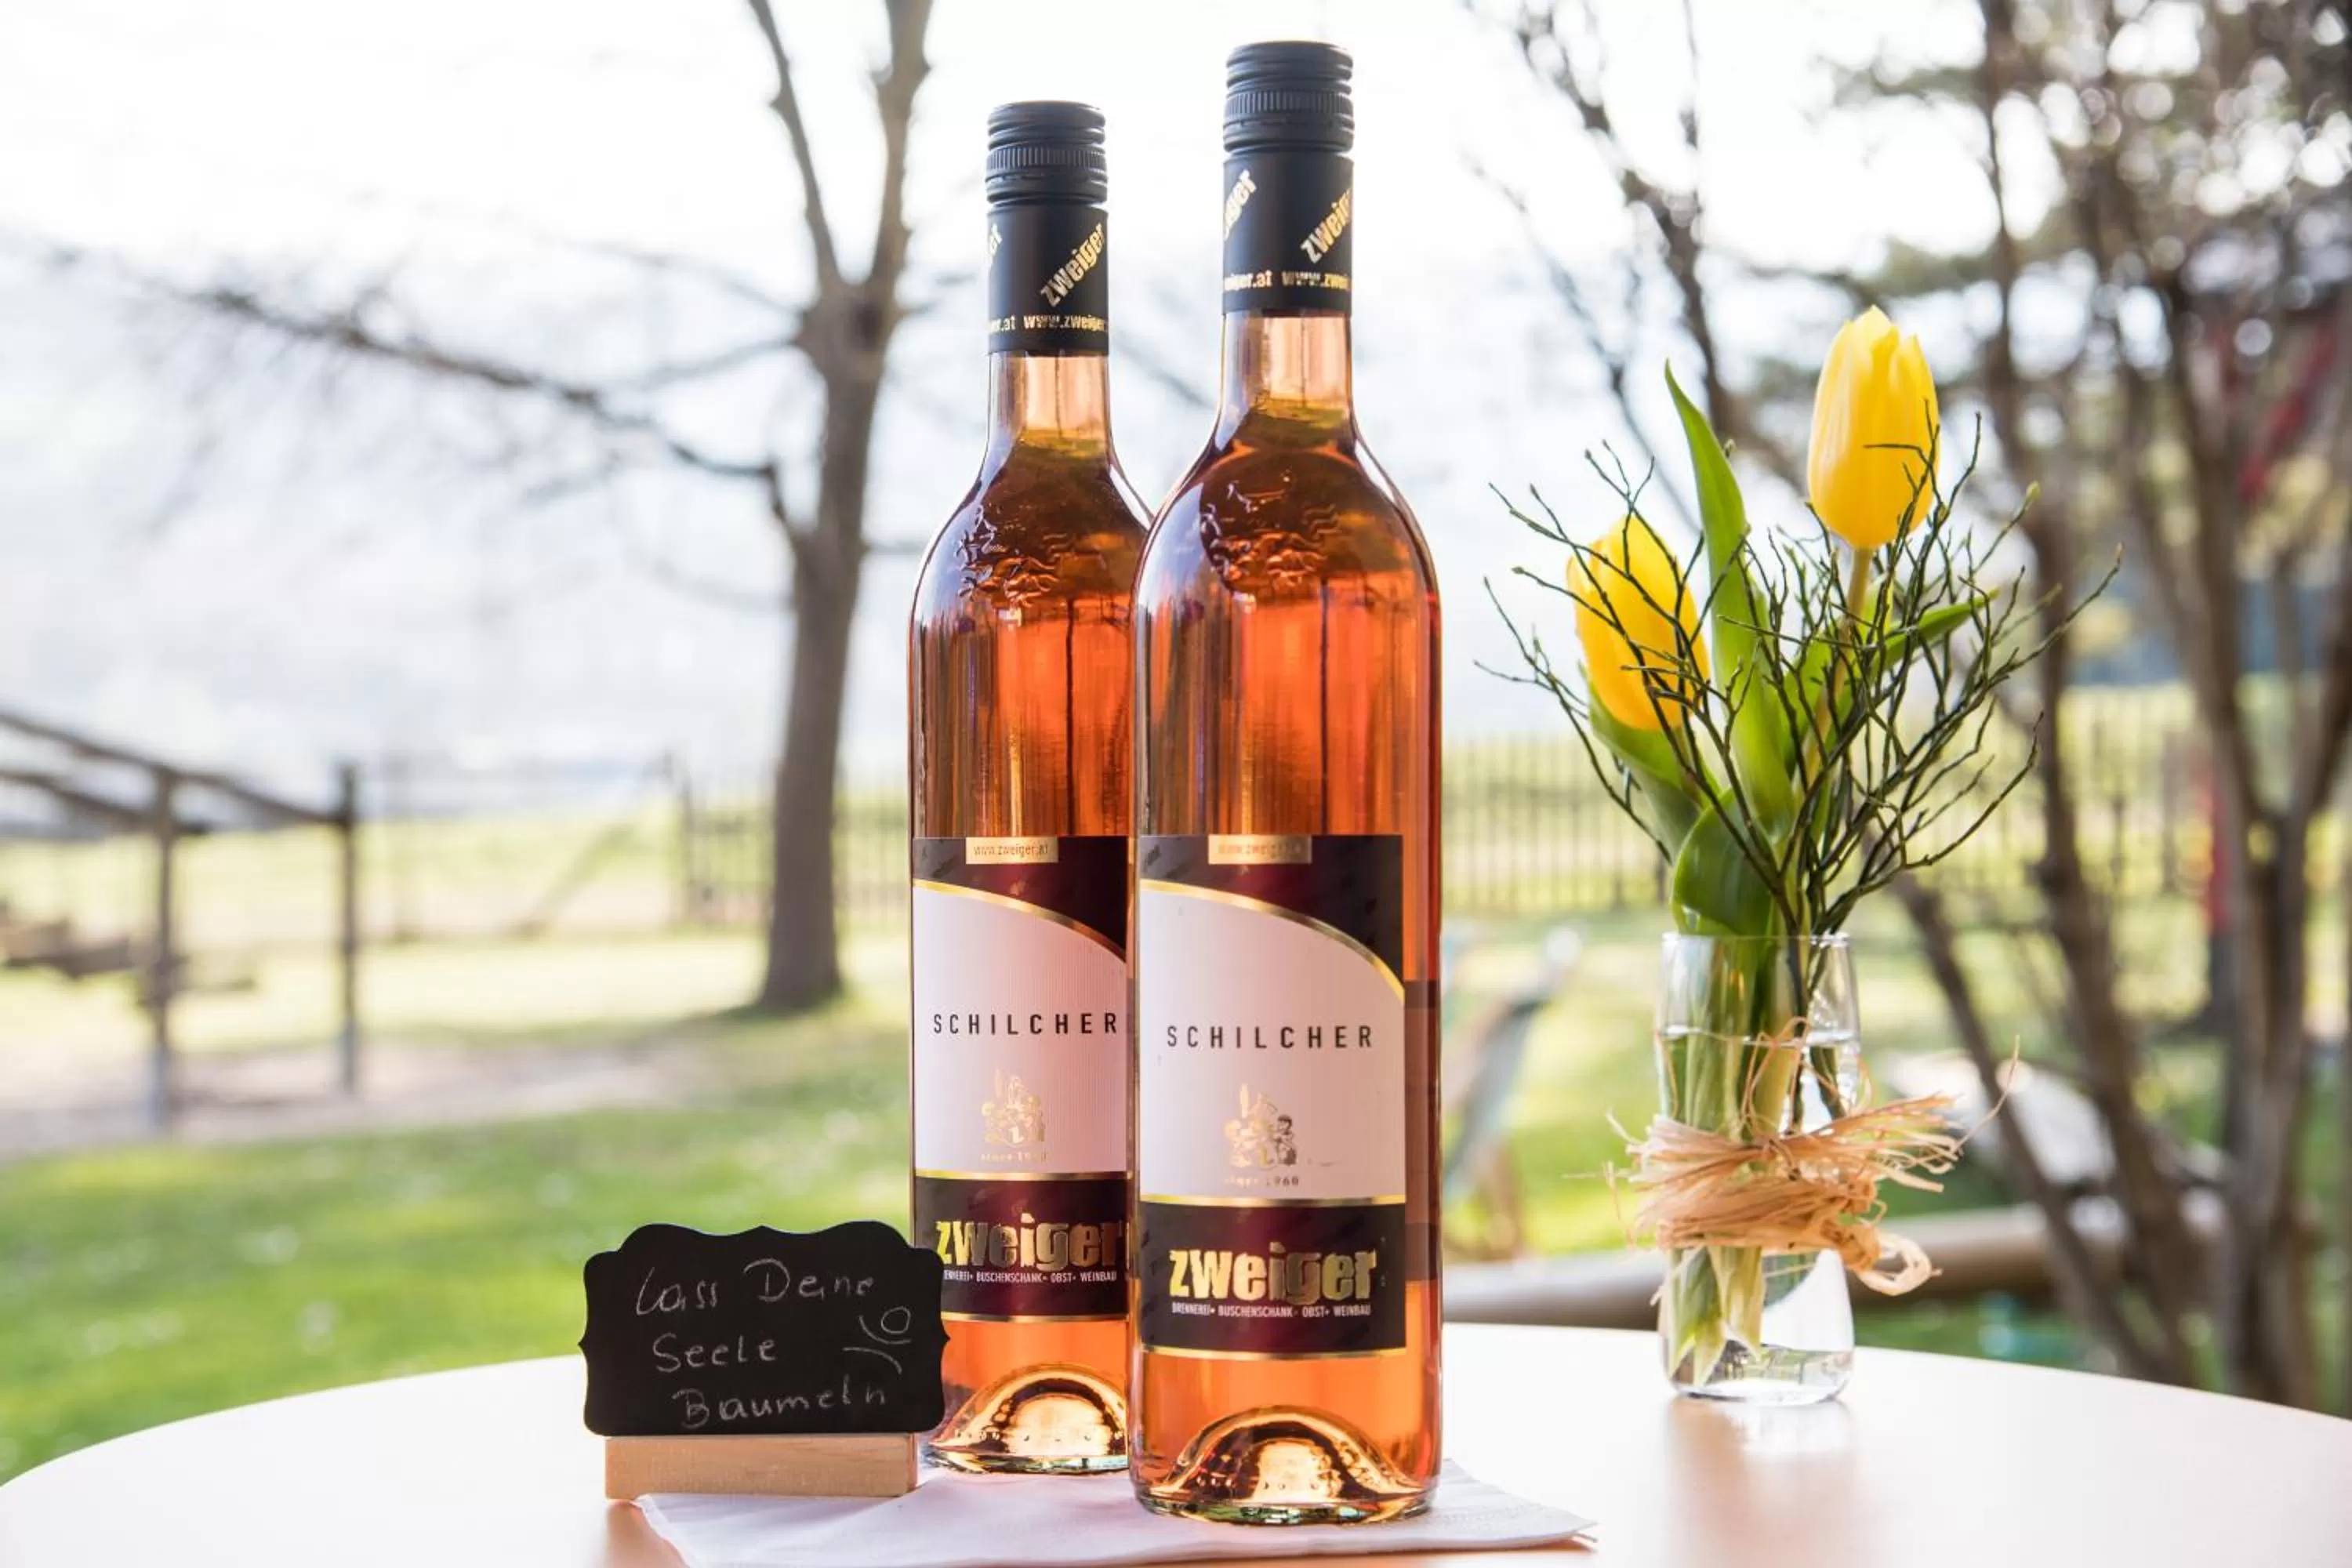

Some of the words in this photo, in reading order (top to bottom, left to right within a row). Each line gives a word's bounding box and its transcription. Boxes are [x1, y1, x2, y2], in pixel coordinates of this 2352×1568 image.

[933, 1012, 1117, 1035] SCHILCHER
[1167, 1025, 1373, 1049] SCHILCHER
[935, 1213, 1123, 1272] zweiger
[636, 1266, 719, 1316] Lass
[743, 1258, 875, 1302] Deine
[1051, 1272, 1073, 1283] OBST
[1080, 1270, 1117, 1283] WEINBAU
[1169, 1241, 1377, 1305] zweiger
[1301, 1305, 1325, 1318] OBST
[1333, 1305, 1371, 1317] WEINBAU
[652, 1333, 778, 1374] Seele
